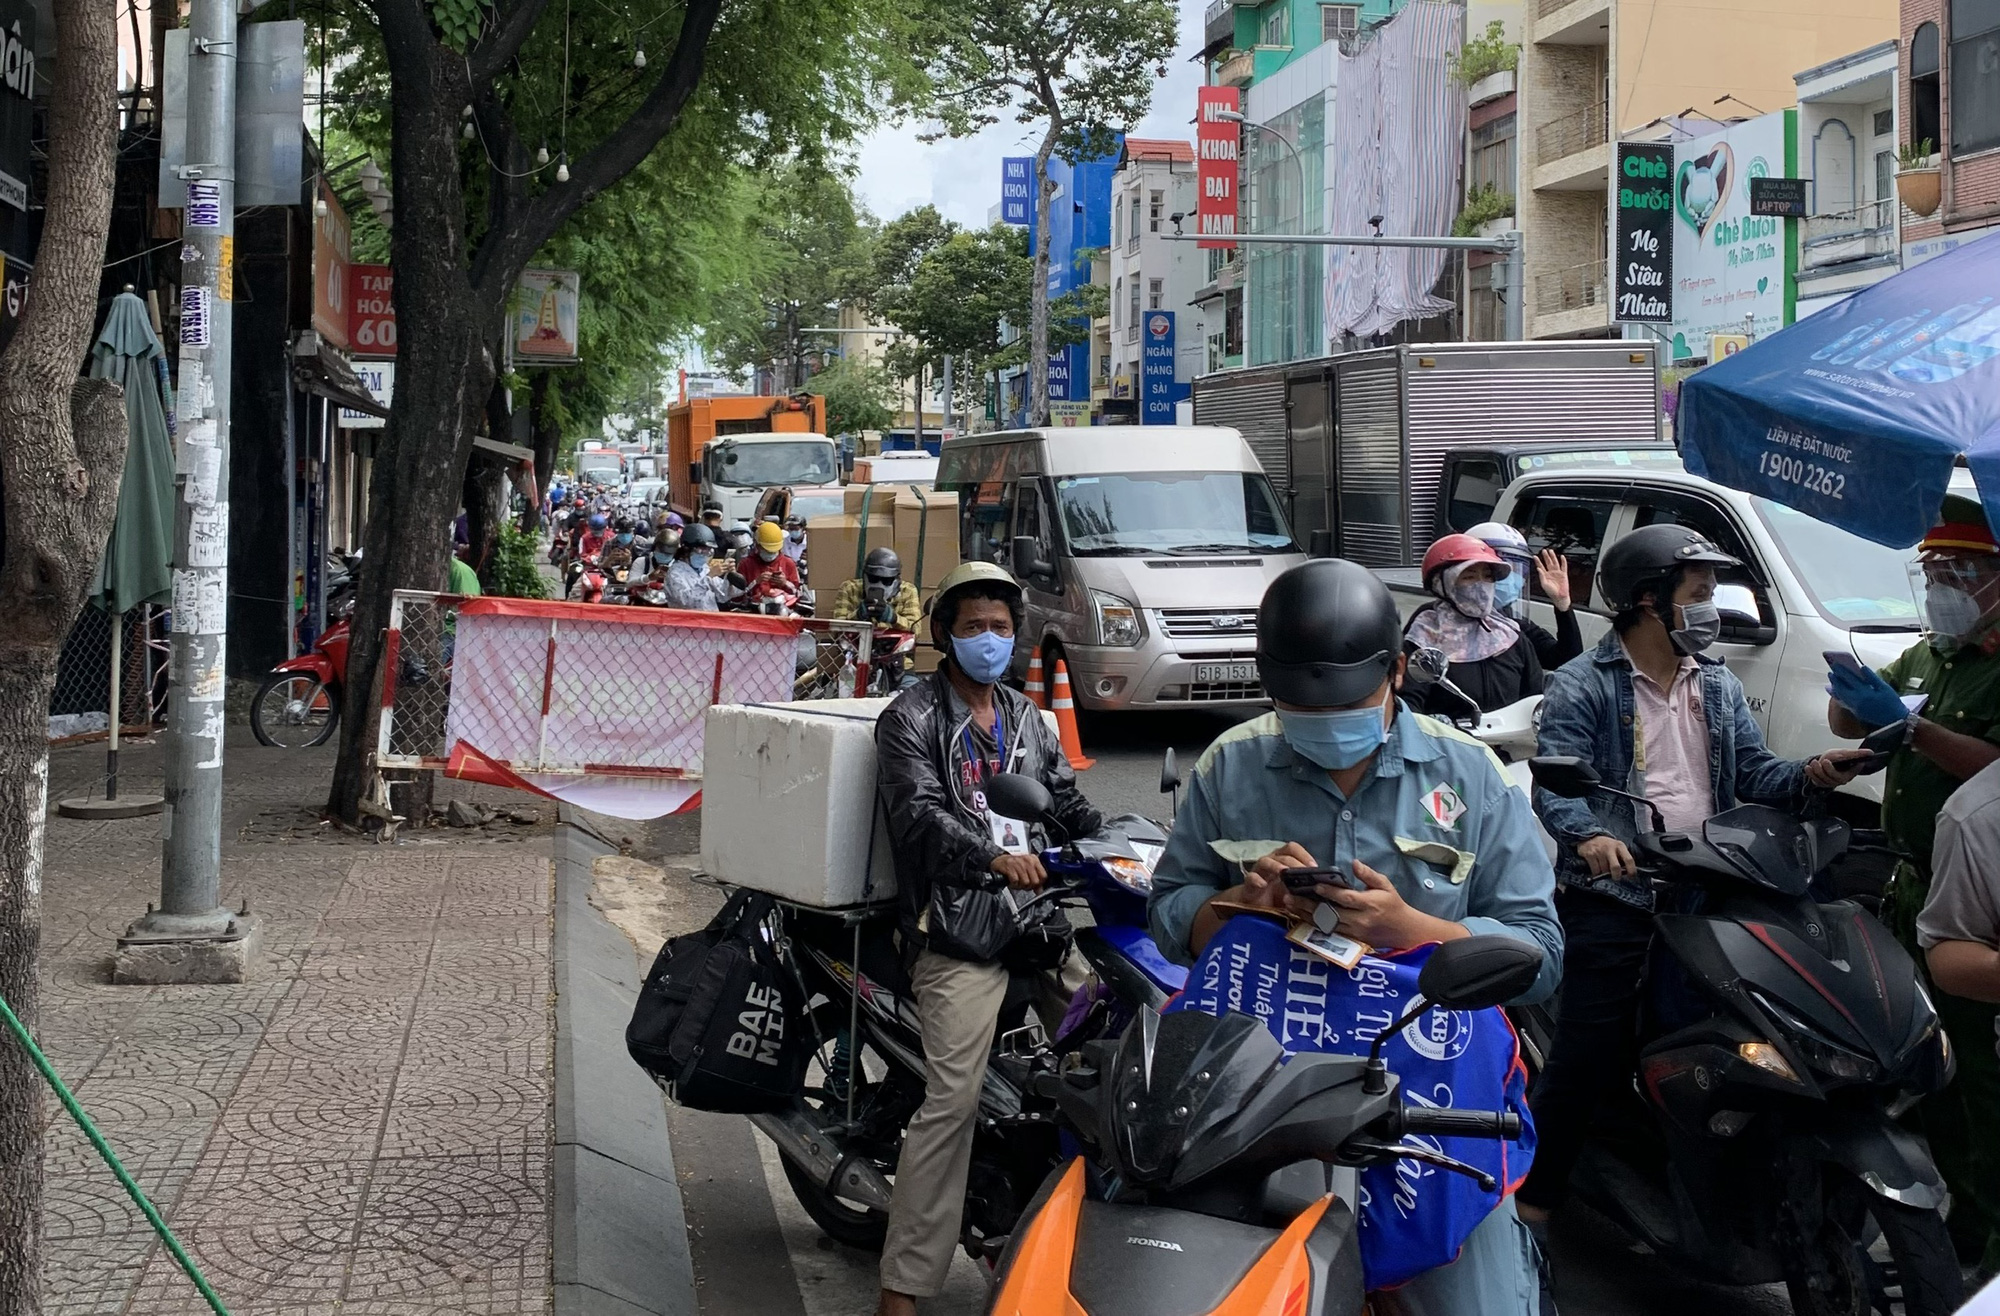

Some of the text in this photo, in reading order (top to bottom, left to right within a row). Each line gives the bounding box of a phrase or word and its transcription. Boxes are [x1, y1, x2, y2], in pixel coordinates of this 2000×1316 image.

[1201, 139, 1237, 161] KHOA
[1007, 163, 1025, 178] NHA
[1623, 154, 1668, 179] Chè
[1004, 183, 1028, 198] KHOA
[1205, 177, 1230, 202] ĐẠI
[1762, 182, 1778, 190] MUA
[1620, 187, 1670, 210] Bưởi
[1008, 203, 1024, 218] KIM
[1202, 214, 1235, 235] NAM
[1714, 216, 1740, 246] Chè
[1630, 229, 1659, 258] Mẹ
[1625, 262, 1664, 287] Siêu
[1619, 292, 1669, 317] Nhân
[356, 319, 396, 346] 60
[1146, 347, 1173, 357] NGÂN
[1146, 363, 1173, 375] HÀNG
[1152, 383, 1168, 394] SÀI
[1149, 401, 1170, 412] GÒN
[1766, 425, 1852, 464] LIÊN HỆ ĐẶT NƯỚC
[1759, 450, 1846, 500] 1900 2262
[1218, 617, 1238, 627] Ford
[1202, 946, 1224, 992] KCN
[726, 981, 770, 1059] BAE
[755, 988, 785, 1067] MIN
[1127, 1236, 1184, 1252] HONDA
